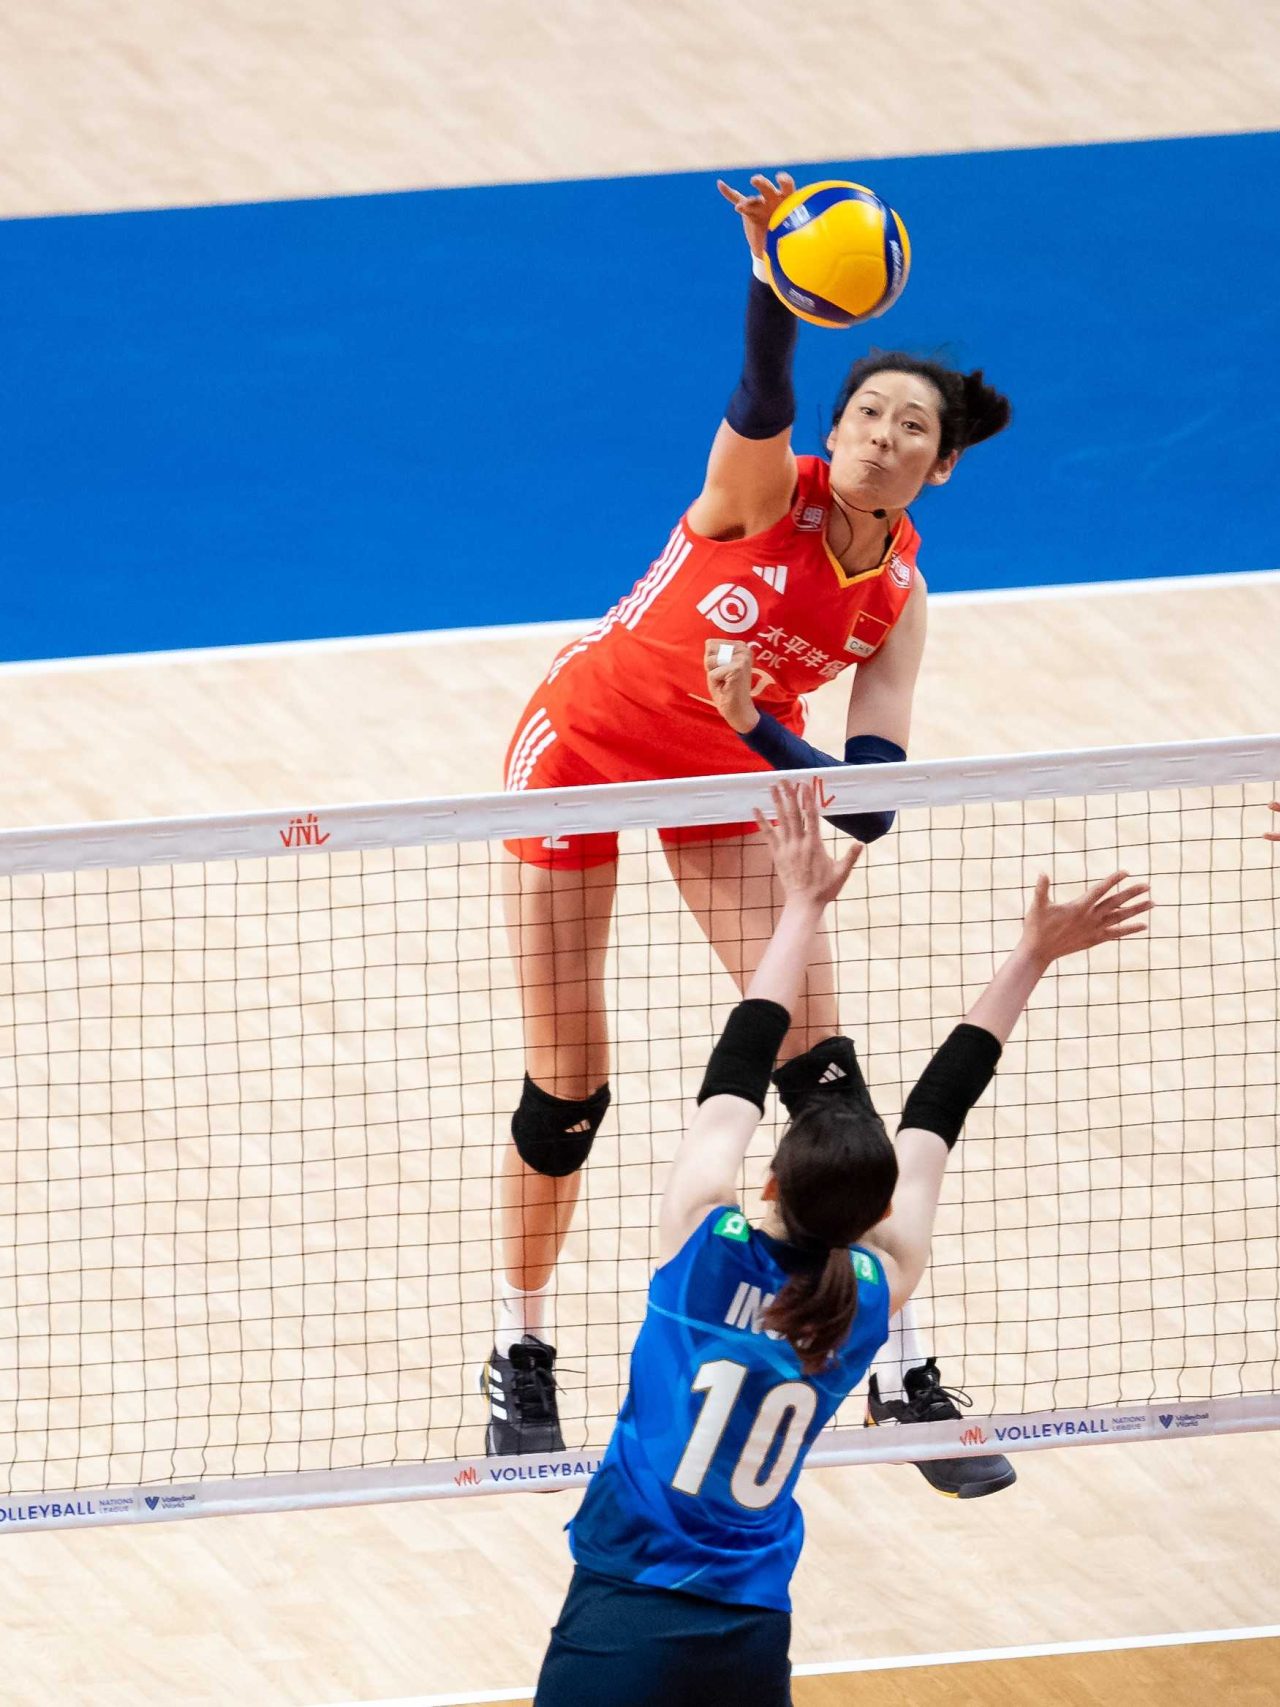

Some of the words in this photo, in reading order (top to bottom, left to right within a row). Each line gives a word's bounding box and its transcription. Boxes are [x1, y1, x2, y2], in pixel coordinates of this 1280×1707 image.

[280, 813, 330, 847] VNL
[672, 1358, 817, 1511] 10
[995, 1418, 1109, 1441] VOLLEYBALL
